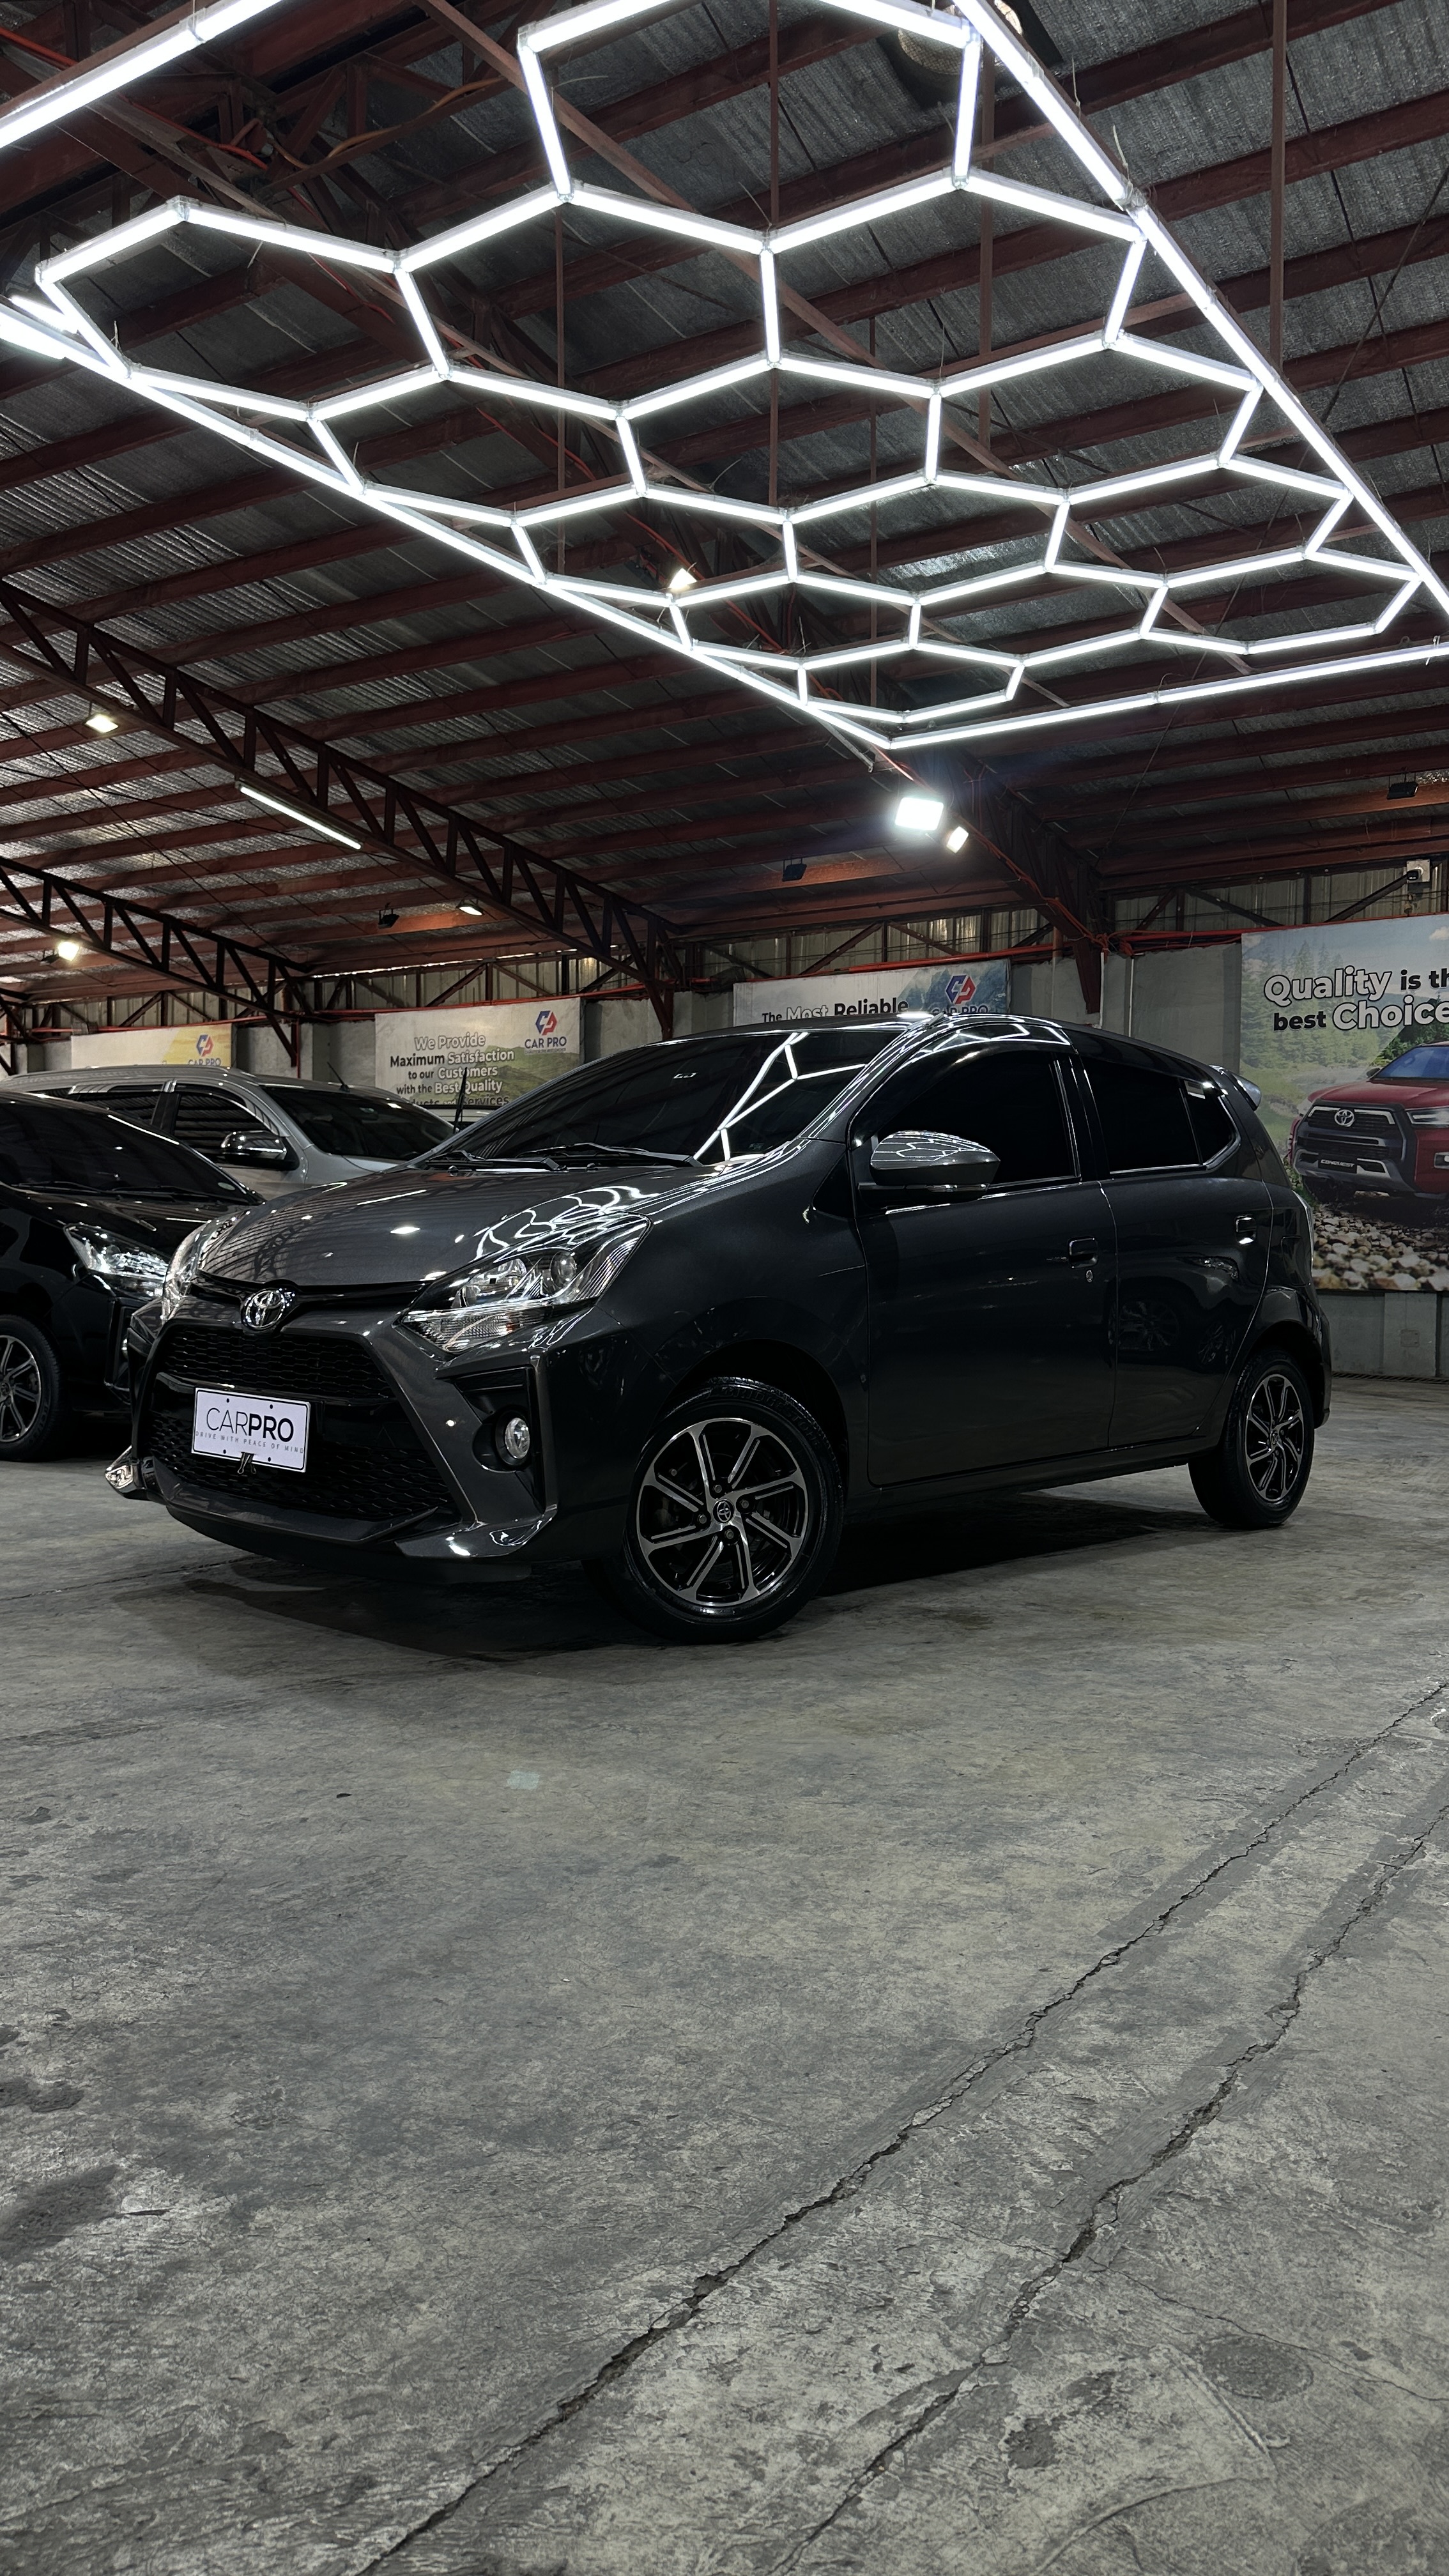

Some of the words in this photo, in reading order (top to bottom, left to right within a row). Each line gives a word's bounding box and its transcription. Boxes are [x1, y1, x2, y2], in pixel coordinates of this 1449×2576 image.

[1263, 965, 1393, 1008] Quality
[1400, 969, 1422, 990] is
[762, 1011, 783, 1023] The
[786, 1004, 829, 1020] Most
[834, 997, 909, 1016] Reliable
[1273, 1011, 1327, 1031] best
[1332, 994, 1449, 1031] Choice
[414, 1036, 436, 1051] We
[438, 1031, 486, 1050] Provide
[525, 1038, 544, 1049] CAR
[547, 1036, 567, 1048] PRO
[390, 1053, 445, 1068] Maximum
[447, 1048, 515, 1065] Satisfaction
[408, 1071, 417, 1080] to
[419, 1071, 434, 1079] our
[396, 1084, 416, 1095] with
[418, 1084, 433, 1094] the
[434, 1081, 460, 1094] Best
[206, 1407, 295, 1443] CARPRO
[195, 1430, 217, 1440] DRIVE
[220, 1434, 240, 1443] WITH
[243, 1438, 266, 1448] PEACE
[284, 1445, 304, 1454] MIND
